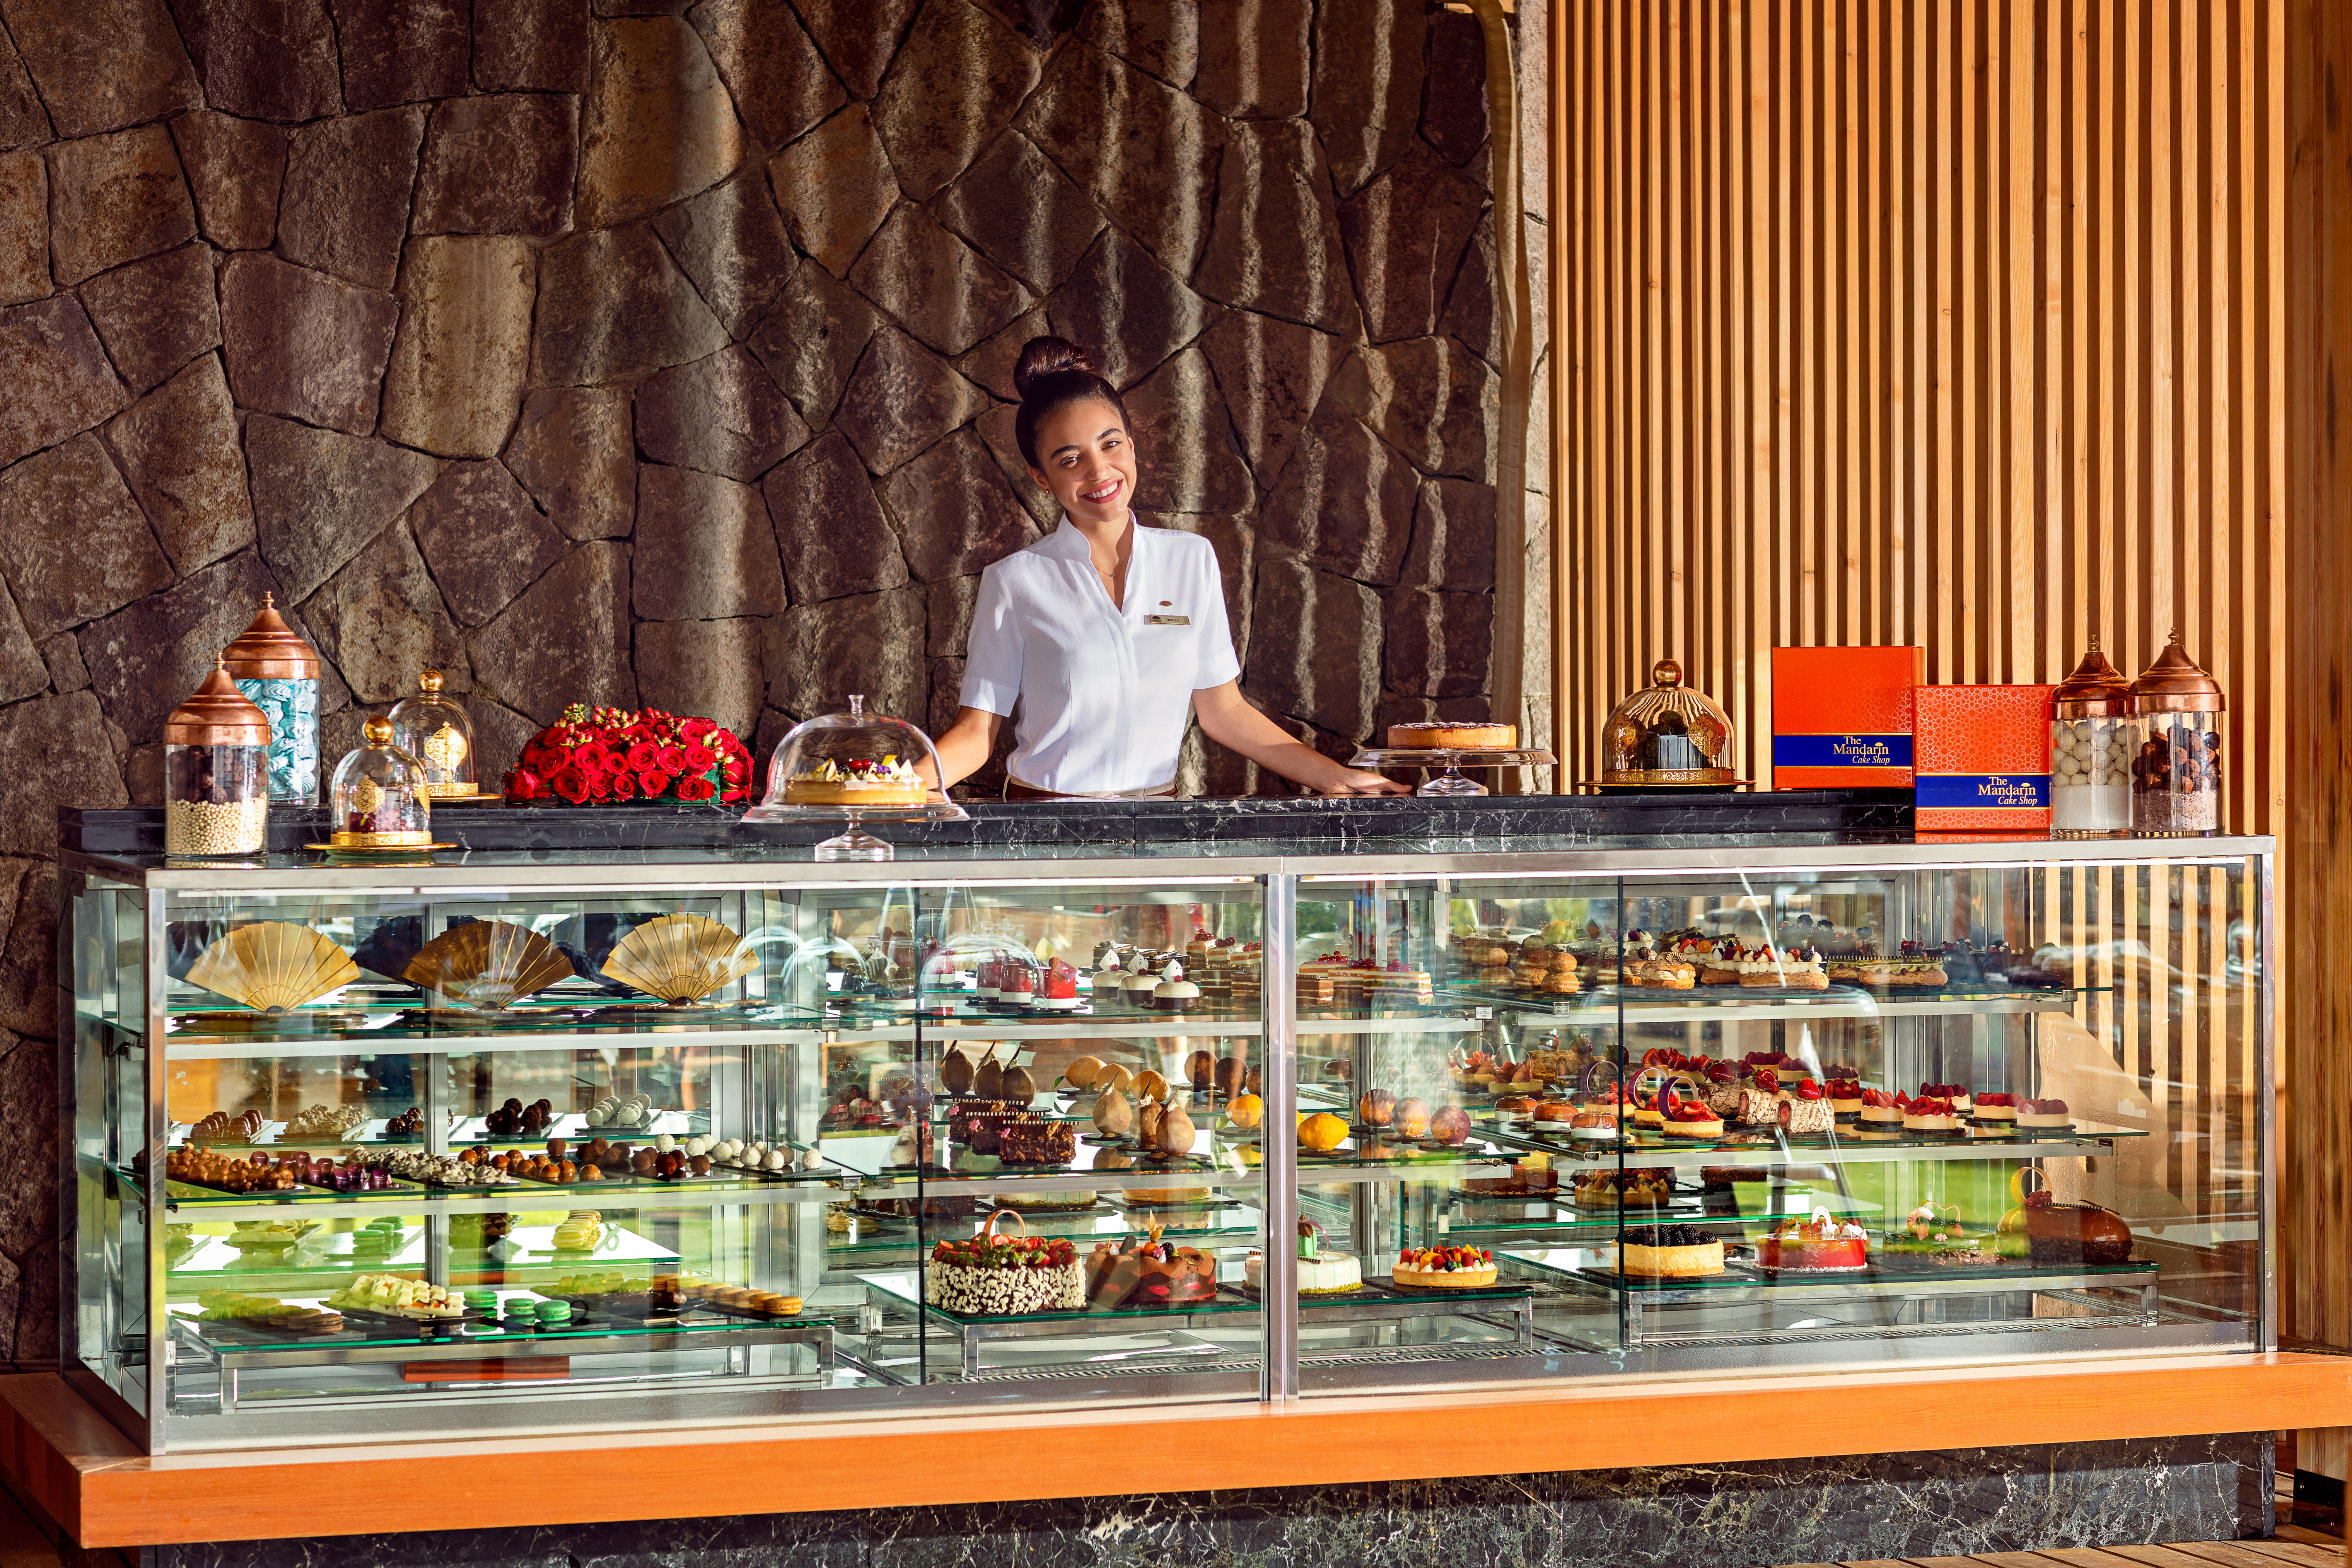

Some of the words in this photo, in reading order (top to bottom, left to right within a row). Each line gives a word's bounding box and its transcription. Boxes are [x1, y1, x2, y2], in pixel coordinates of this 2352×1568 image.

[1843, 736, 1861, 745] The
[1833, 744, 1889, 754] Mandarin
[1852, 755, 1870, 763] Cake
[1872, 755, 1890, 765] Shop
[1988, 776, 2007, 785] The
[1978, 784, 2036, 795] Mandarin
[1998, 795, 2017, 804] Cake
[2019, 795, 2037, 806] Shop
